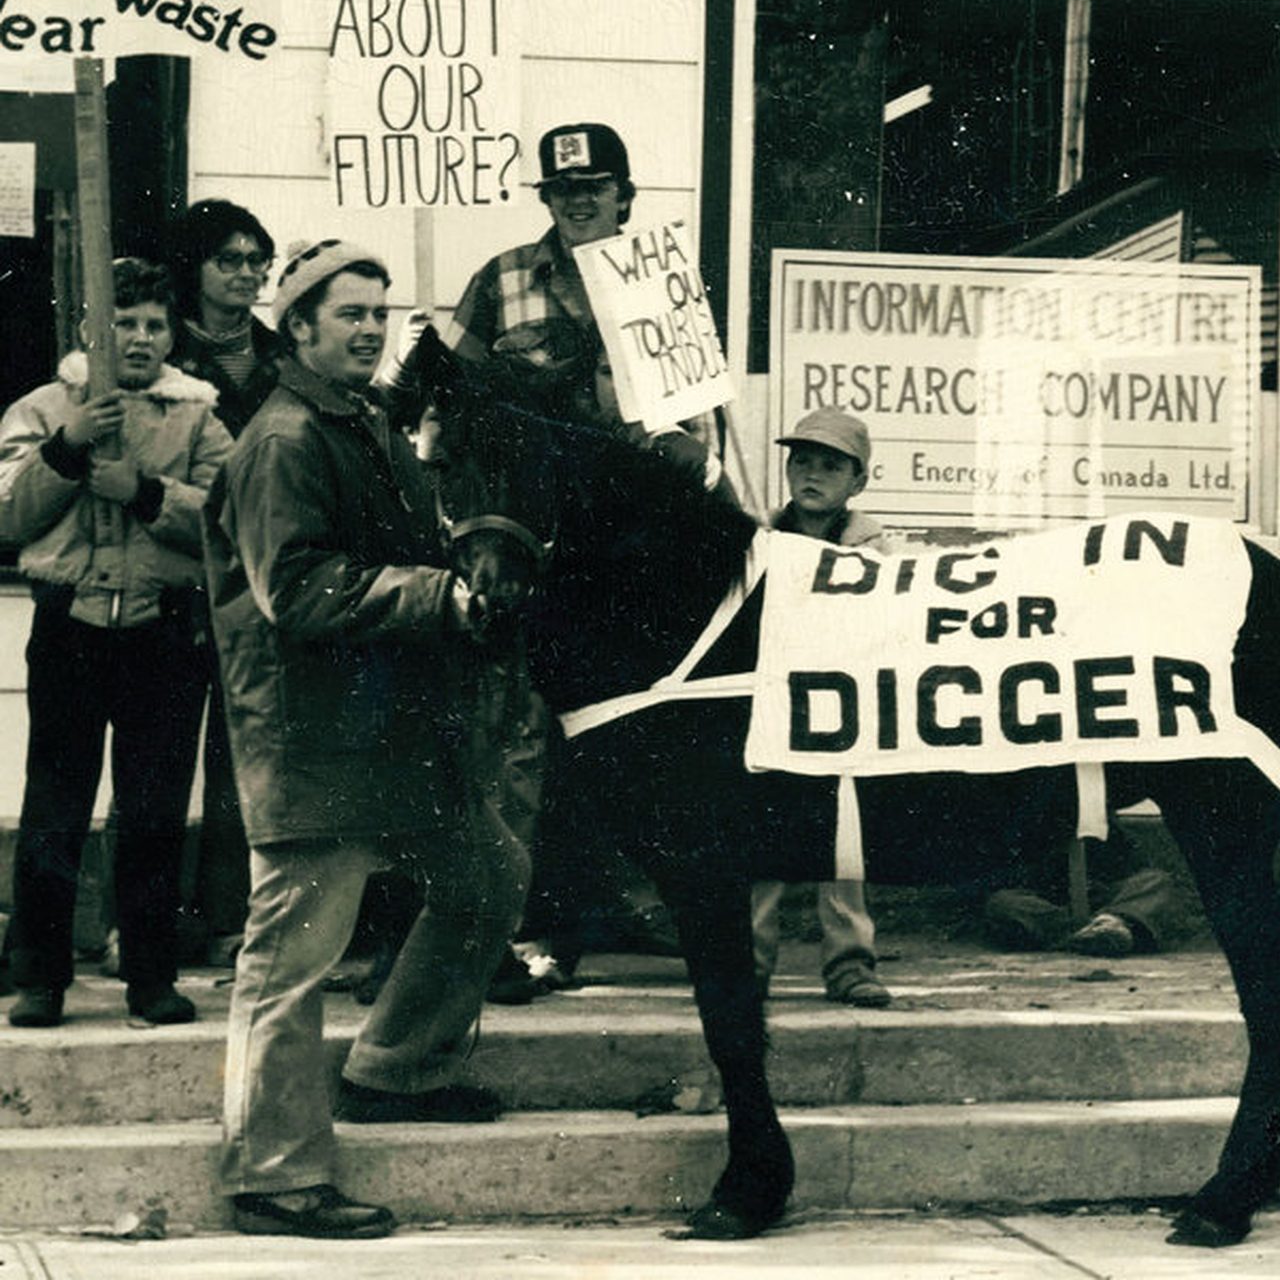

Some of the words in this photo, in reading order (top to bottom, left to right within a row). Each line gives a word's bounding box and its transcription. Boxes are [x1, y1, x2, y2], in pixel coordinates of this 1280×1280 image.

[378, 64, 486, 133] OUR
[334, 133, 521, 207] FUTURE?
[601, 220, 688, 285] WHA
[667, 271, 705, 311] OU
[791, 279, 1063, 341] INFORMATION
[1090, 291, 1239, 345] CENTRE
[657, 338, 728, 399] INDU
[803, 363, 1005, 416] RESEARCH
[1039, 370, 1228, 423] COMPANY
[912, 453, 999, 489] Energy
[1189, 460, 1236, 490] Ltd.
[1083, 520, 1189, 567] IN
[926, 596, 1057, 644] FOR
[788, 655, 1218, 753] DIGGER
